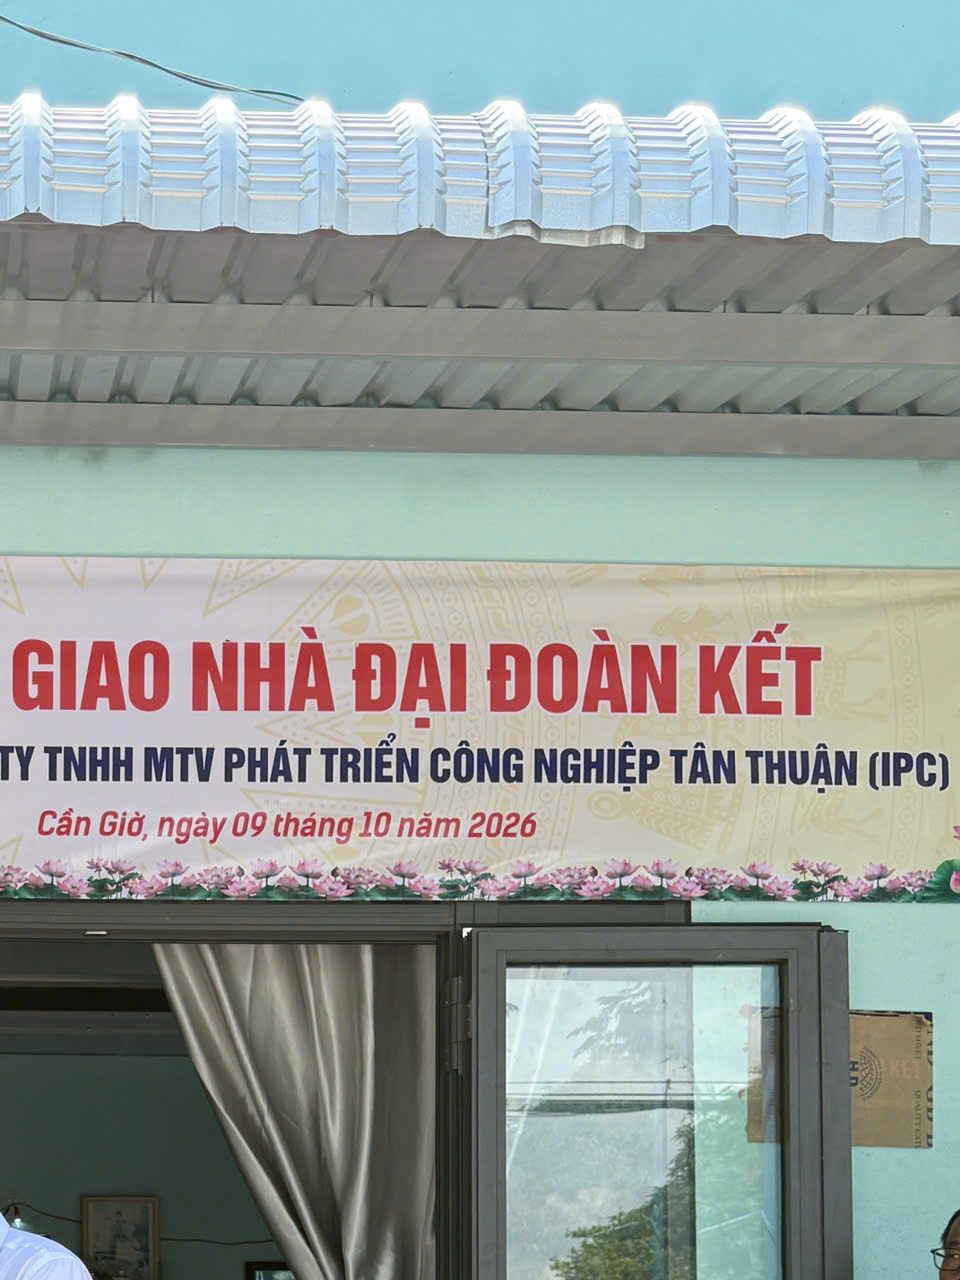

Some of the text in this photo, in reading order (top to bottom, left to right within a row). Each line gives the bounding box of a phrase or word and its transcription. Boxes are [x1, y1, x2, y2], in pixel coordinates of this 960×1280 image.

[11, 639, 171, 712] GIAO
[192, 626, 335, 712] NHÀ
[352, 642, 467, 729] ĐẠI
[486, 630, 677, 715] ĐOÀN
[698, 623, 822, 717] KẾT
[44, 746, 133, 782] TNHH
[143, 747, 214, 783] MTV
[225, 739, 312, 783] PHÁT
[321, 733, 420, 783] TRIỂN
[430, 740, 524, 784] CÔNG
[534, 741, 660, 792] NGHIỆP
[670, 742, 737, 784] TÂN
[745, 743, 858, 794] THUẬN
[869, 752, 949, 792] (IPC)
[37, 809, 537, 845] Cần Giờ, ngày 09 tháng 10 năm 2026
